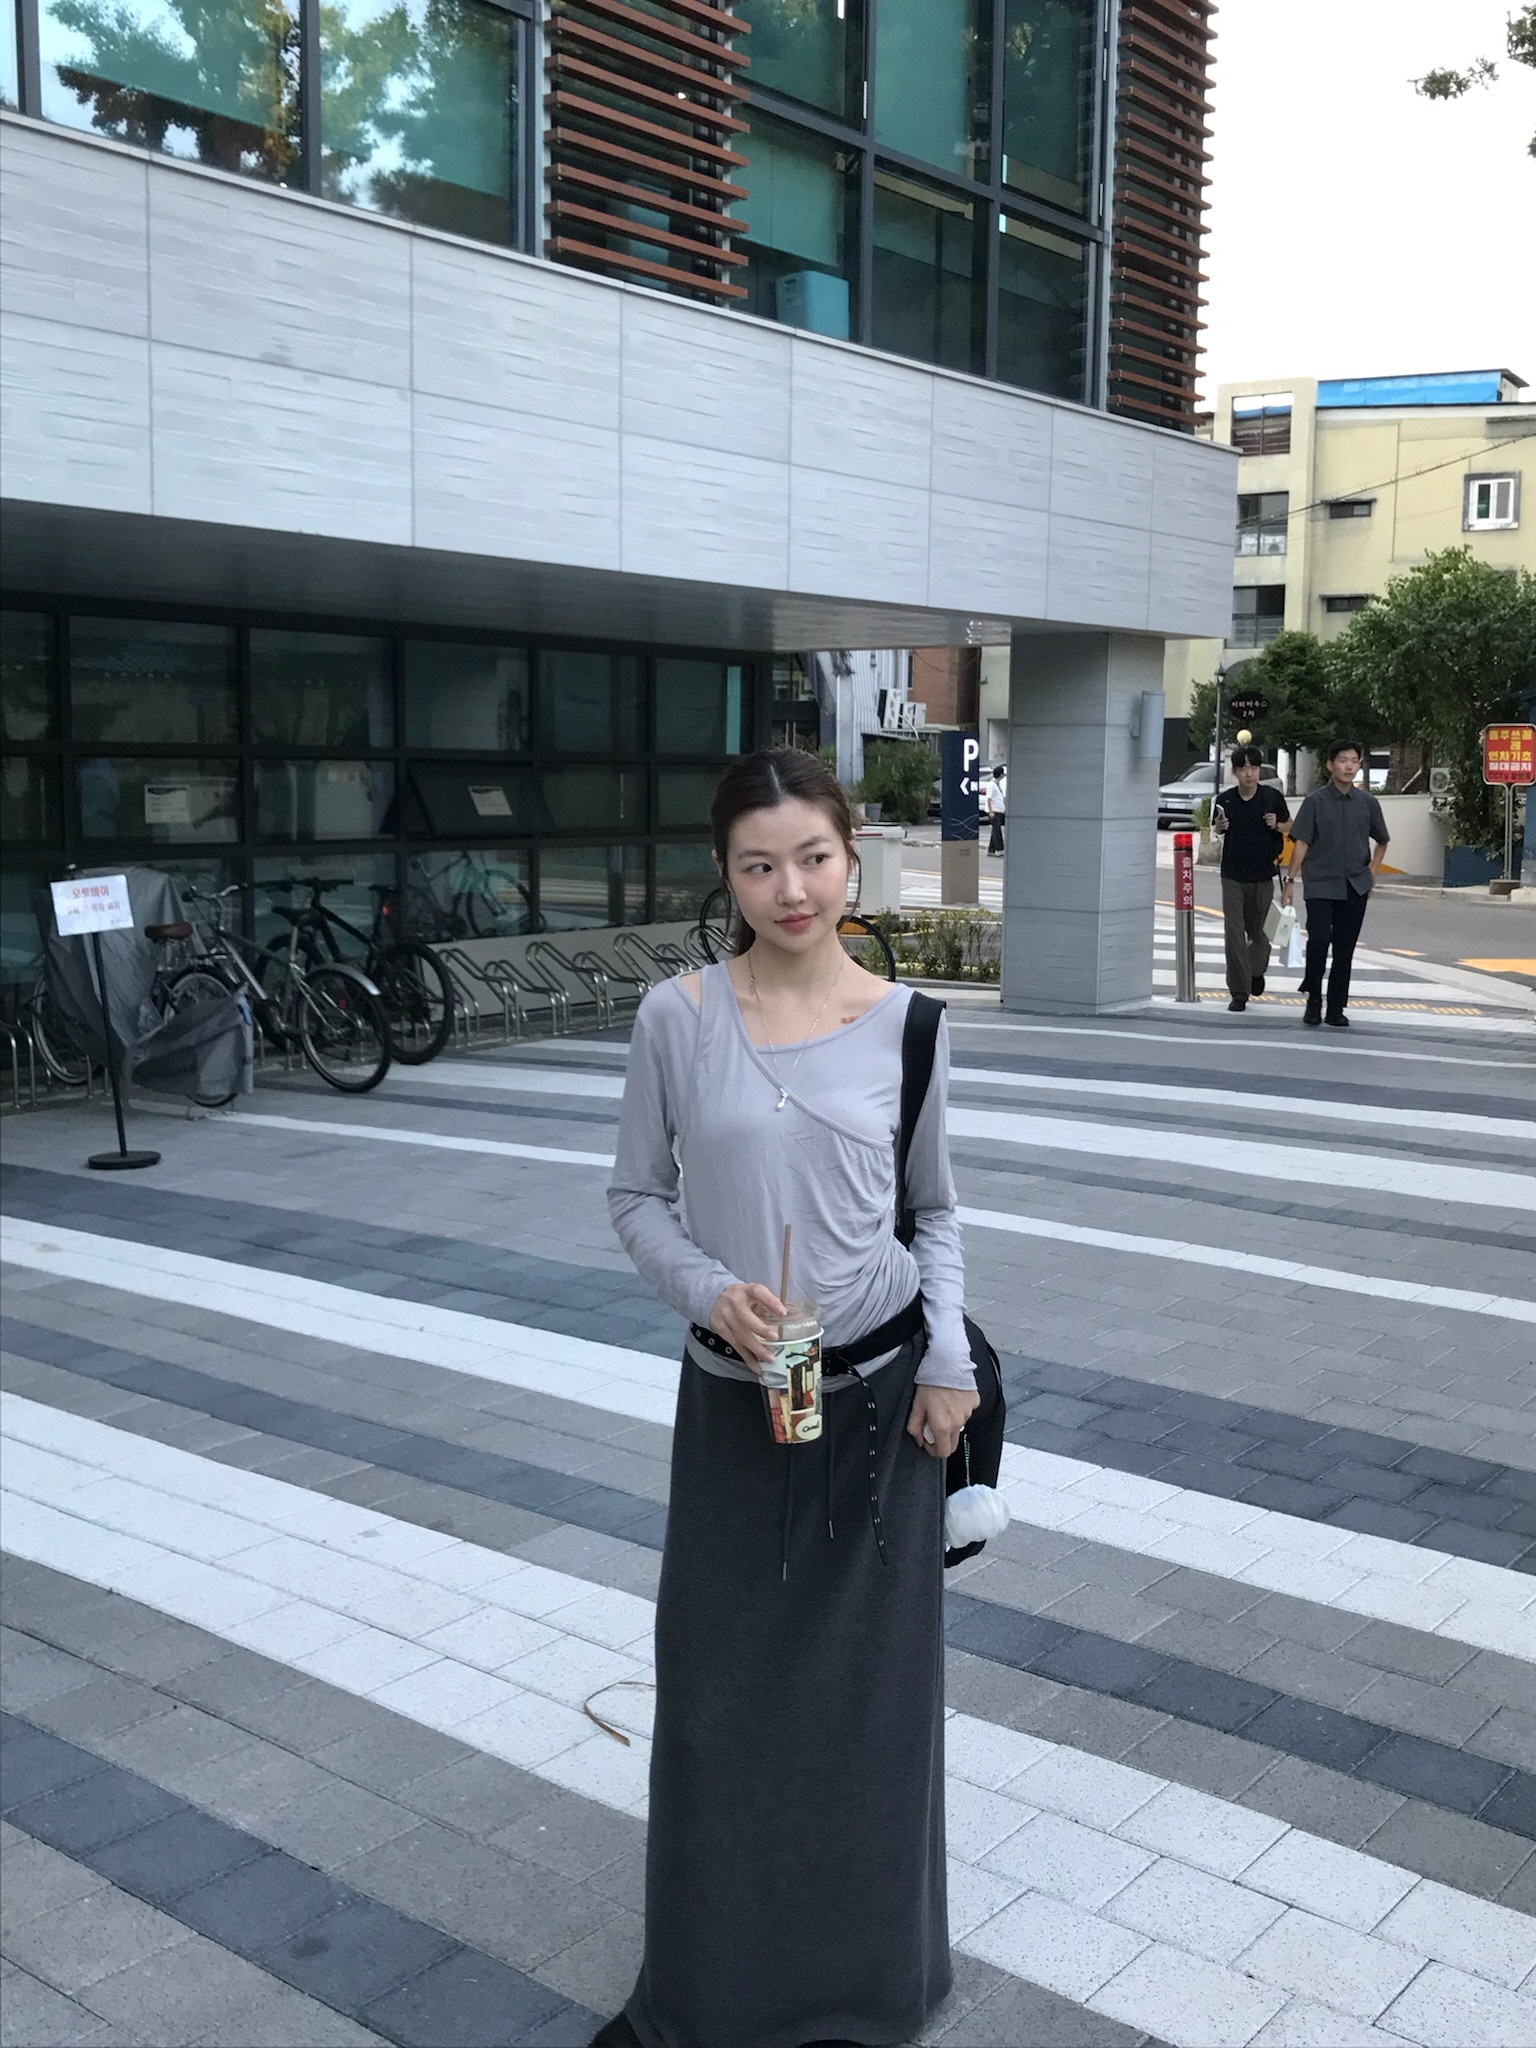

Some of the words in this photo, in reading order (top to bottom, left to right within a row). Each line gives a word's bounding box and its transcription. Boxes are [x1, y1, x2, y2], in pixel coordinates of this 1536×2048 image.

[963, 738, 979, 773] P
[72, 884, 109, 899] 오토바이
[1182, 856, 1192, 907] 출차주의
